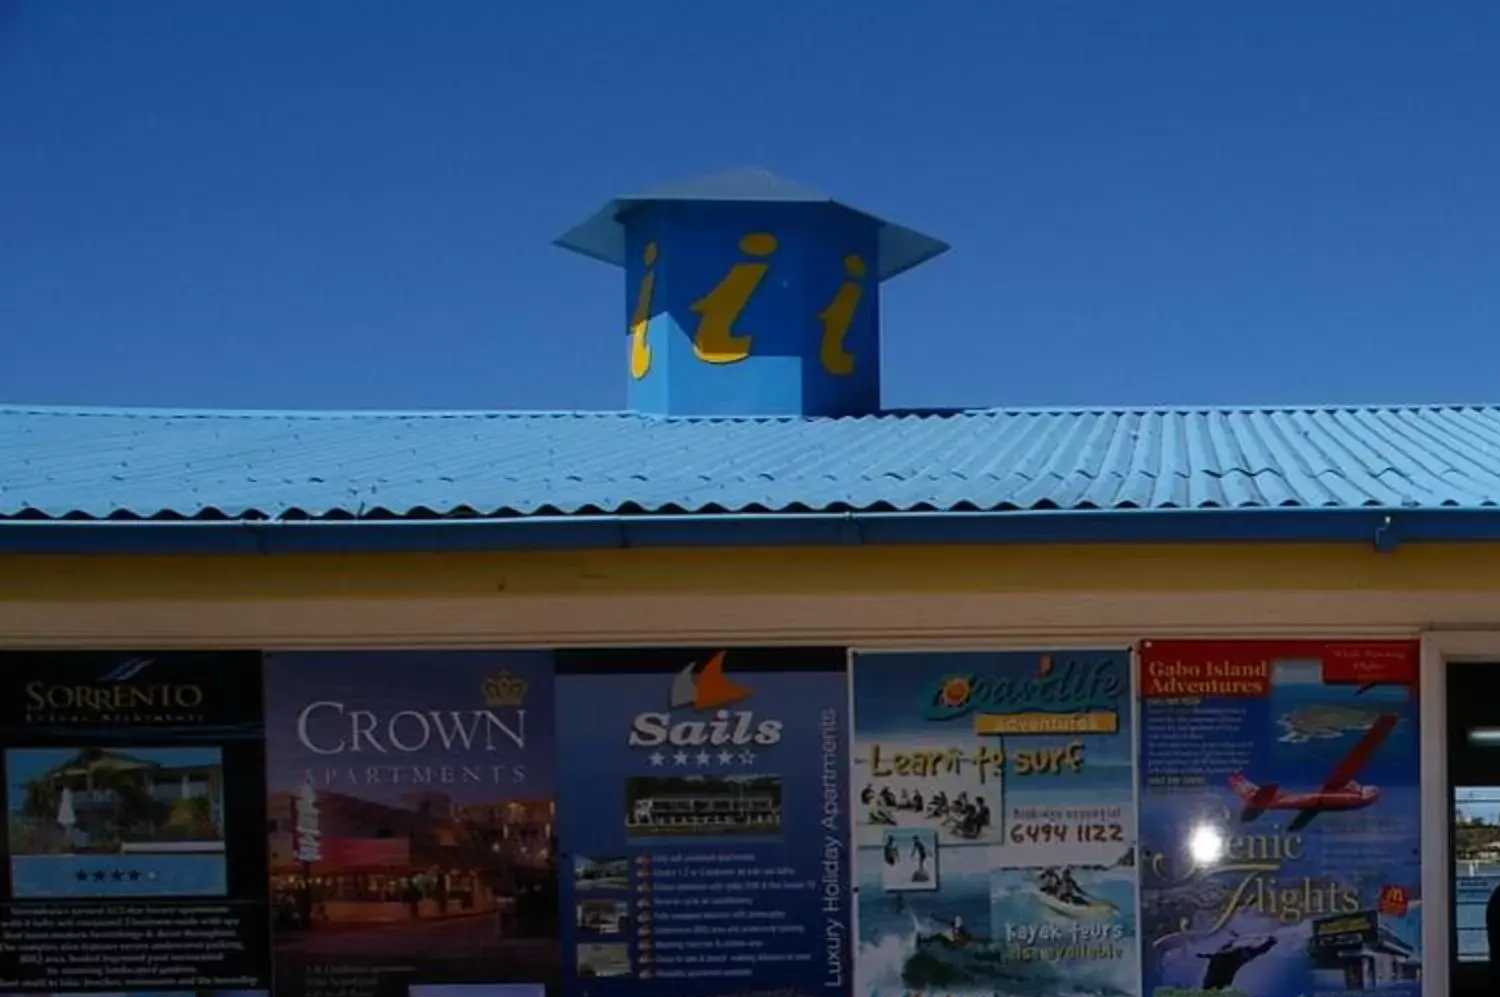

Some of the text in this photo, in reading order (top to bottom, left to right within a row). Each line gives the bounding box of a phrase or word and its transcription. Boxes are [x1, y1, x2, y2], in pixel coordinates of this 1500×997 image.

[1148, 660, 1267, 677] Gabo Island
[24, 680, 204, 712] SORRENTO
[1148, 678, 1264, 694] Adventures
[297, 700, 528, 755] CROWN
[628, 709, 784, 746] Sails
[302, 764, 528, 785] APARTMENTS
[870, 741, 1086, 785] Learn to surf
[819, 707, 845, 987] Luxury Holiday Apartments
[1010, 824, 1068, 844] 6494
